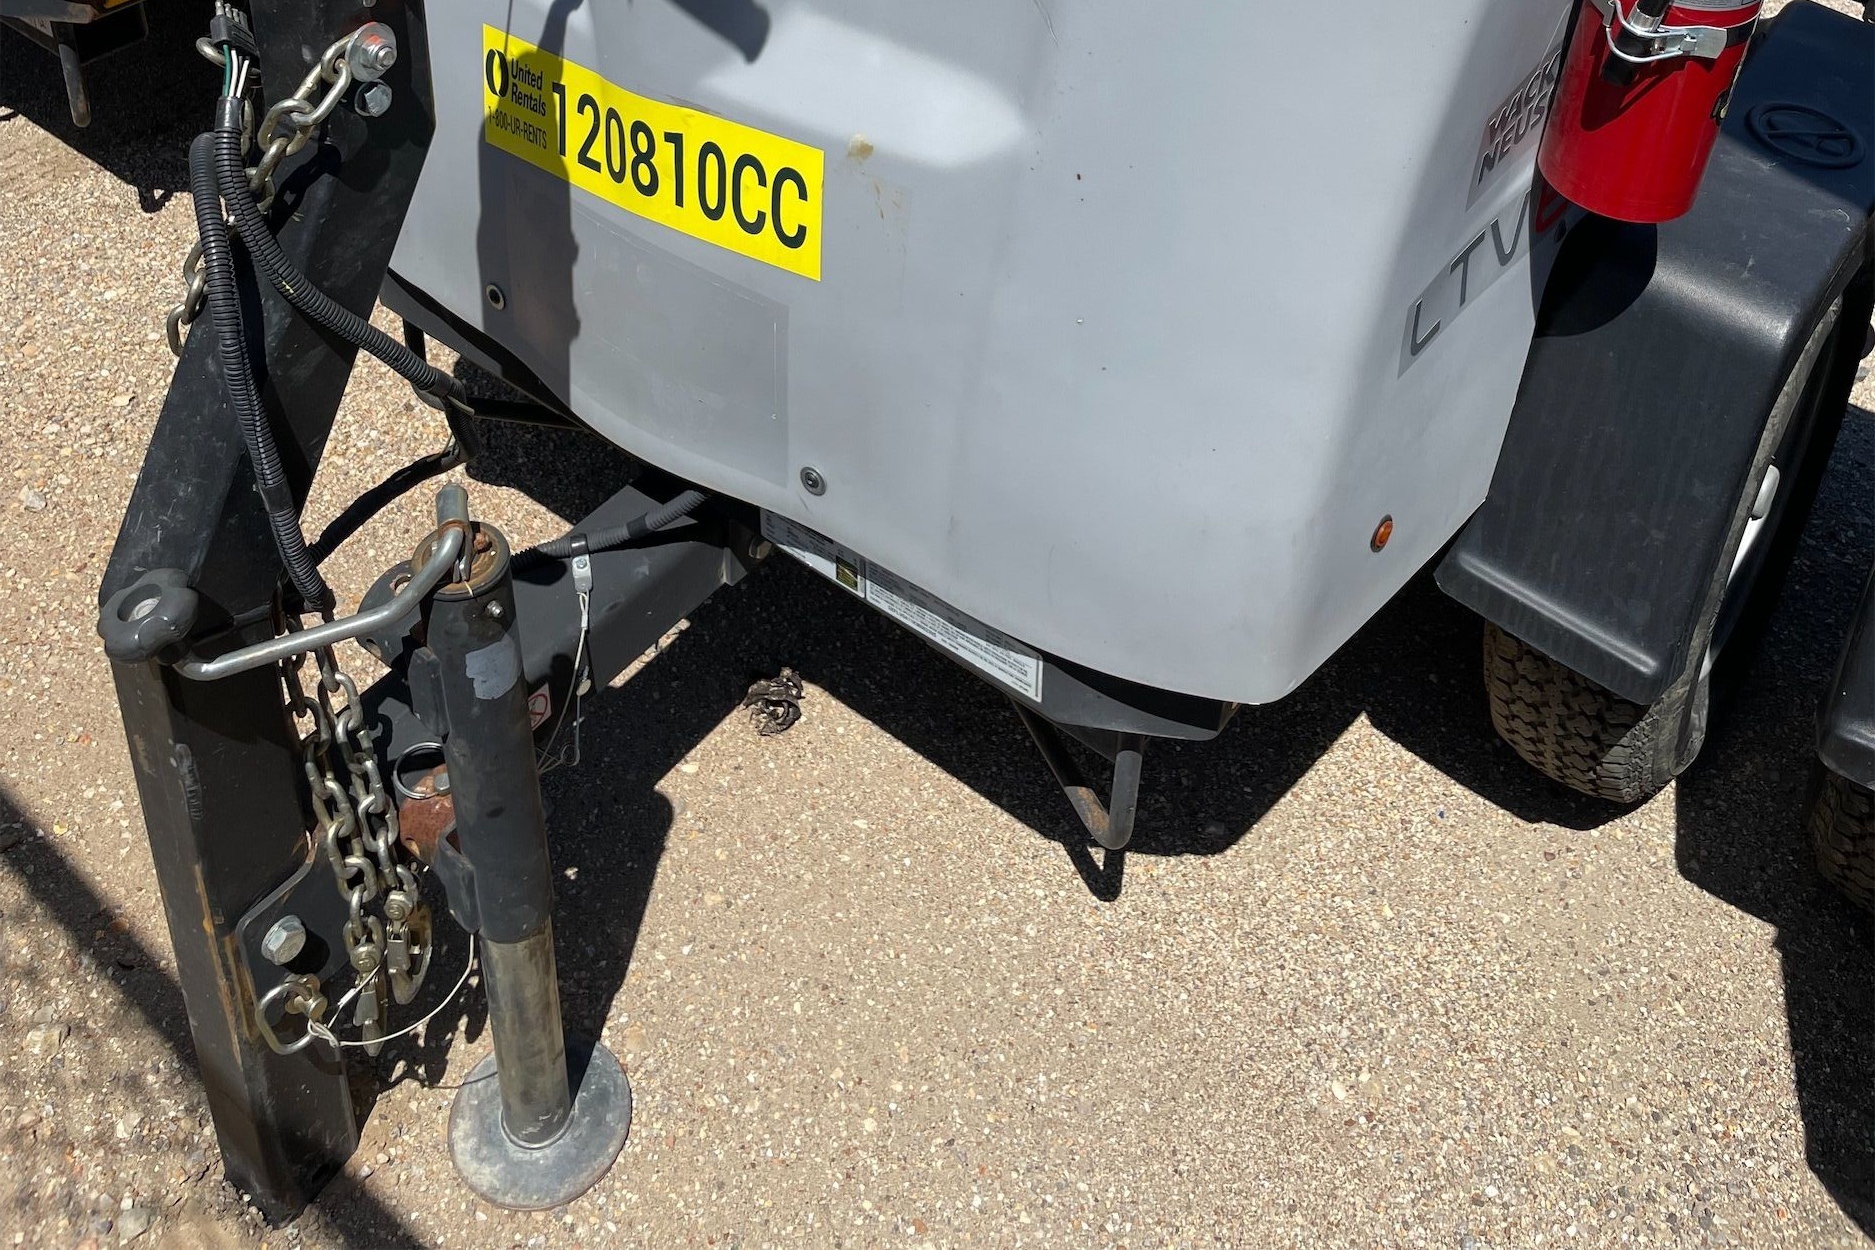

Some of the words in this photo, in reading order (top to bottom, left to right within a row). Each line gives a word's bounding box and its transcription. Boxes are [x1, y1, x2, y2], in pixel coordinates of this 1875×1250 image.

[511, 57, 543, 92] United
[511, 82, 547, 117] Rentals
[1489, 50, 1562, 145] WACK
[488, 105, 547, 150] 1-800-UR-RENTS
[1478, 85, 1551, 186] NEUS
[552, 81, 808, 250] 120810CC
